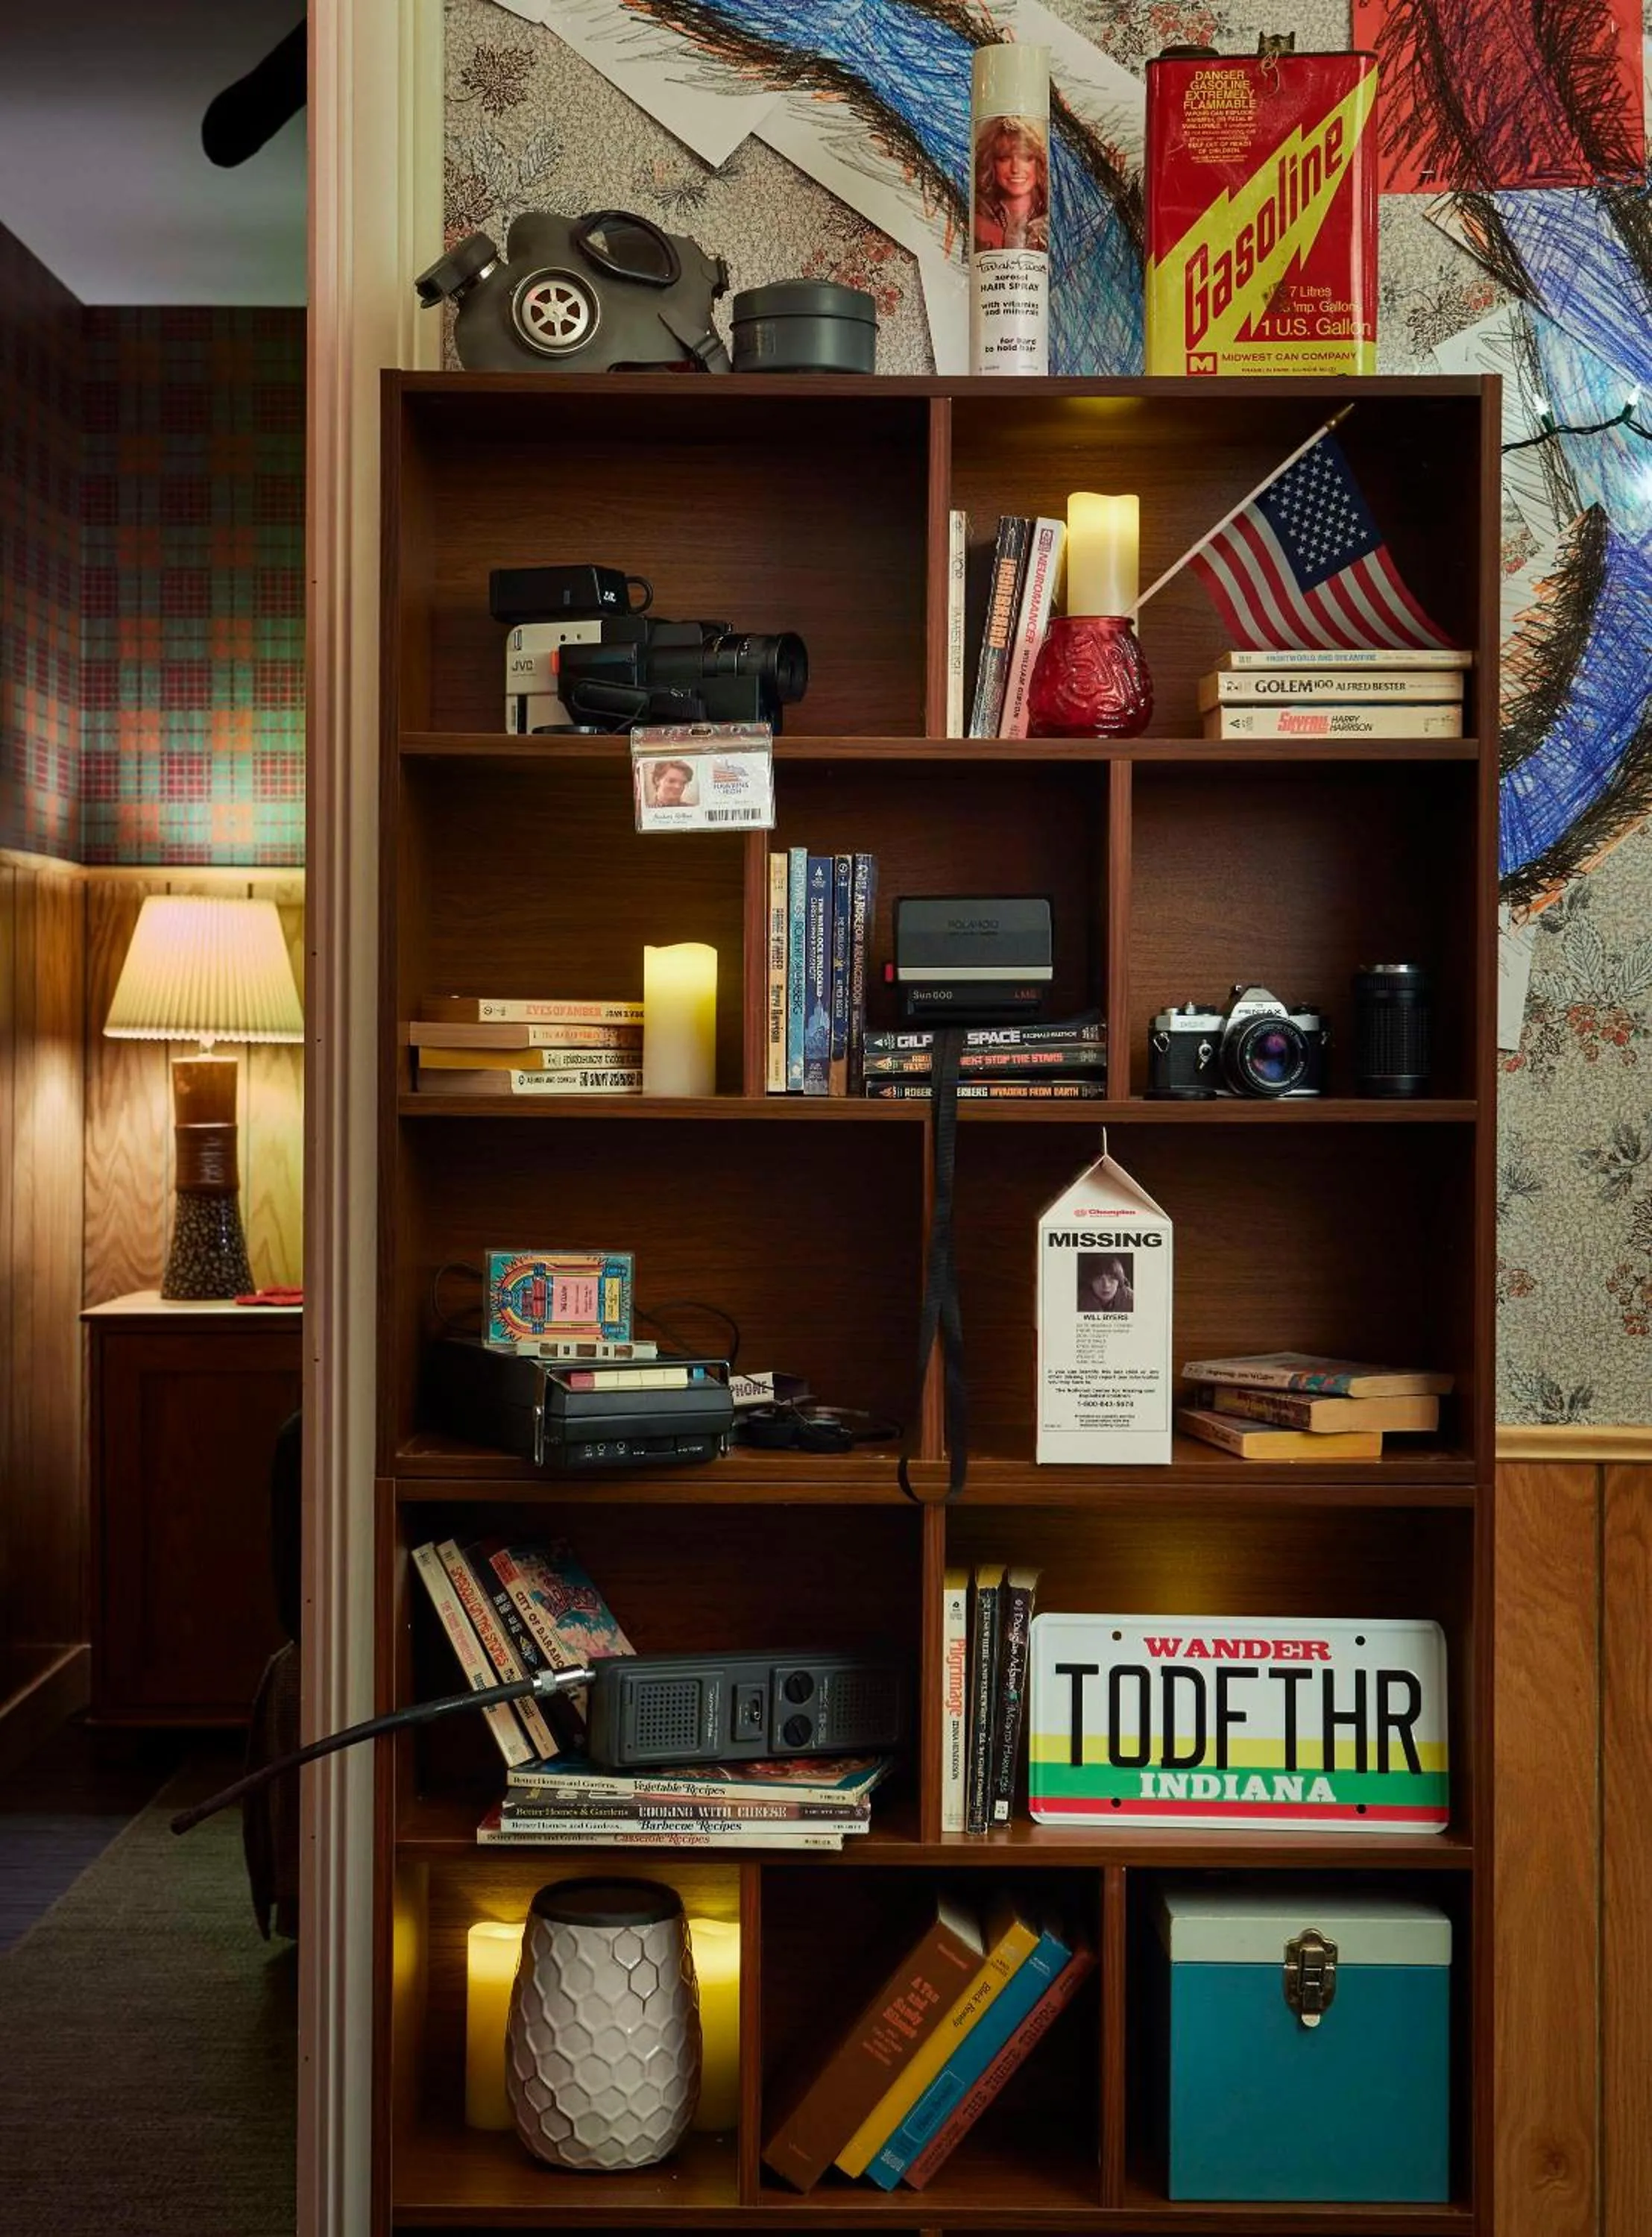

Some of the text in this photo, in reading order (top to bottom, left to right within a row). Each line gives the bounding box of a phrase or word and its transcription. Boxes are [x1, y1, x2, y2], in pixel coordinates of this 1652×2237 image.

[1195, 70, 1244, 81] DANGER
[1190, 80, 1250, 90] GASOLINE
[1185, 89, 1255, 100] EXTREMELY
[1183, 99, 1257, 110] FLAMMABLE
[1185, 116, 1344, 351] Gasoline
[980, 283, 1039, 292] HAIR SPRAY
[1299, 286, 1331, 298] Litres
[981, 301, 1000, 309] with
[1262, 318, 1371, 336] 1 U.S. Gallon
[1222, 353, 1273, 362] MIDWEST
[1302, 352, 1357, 360] COMPANY
[1026, 553, 1049, 644] NEUROMANCER
[512, 660, 533, 671] JVC
[1012, 649, 1032, 719] WILLIAM GIBSON
[1335, 682, 1371, 690] ALFRED
[1372, 682, 1406, 690] BESTER
[1331, 715, 1361, 723] HARRY
[1329, 723, 1373, 731] HARRISON
[794, 850, 805, 919] NIGHTWINGS
[855, 901, 865, 925] ROSE
[854, 925, 864, 943] FOR
[792, 921, 804, 1015] ROBERT SILVERBERG
[852, 944, 864, 1005] ARMAGEDDON
[913, 990, 932, 999] Sun
[933, 990, 953, 1000] 600
[897, 1030, 1021, 1048] GILP SPACE
[960, 1052, 1064, 1066] NEXT STOP THE STARS
[904, 1087, 988, 1097] ROBER ERBERG
[990, 1086, 1079, 1097] INVADERS FROM EARTH
[1048, 1233, 1163, 1248] MISSING
[450, 1565, 476, 1605] SHADOW
[516, 1591, 565, 1669] CITY OF BARABO
[1008, 1613, 1024, 1692] Douglas Adams
[1144, 1637, 1332, 1661] WANDER
[947, 1637, 966, 1717] Pilgrimage
[1055, 1664, 1422, 1775] TODFTHR
[951, 1720, 960, 1780] ZENNA HENDERSON
[566, 1779, 581, 1787] and
[634, 1780, 726, 1796] Vegetable Recipes
[1140, 1772, 1337, 1803] INDIANA
[516, 1808, 628, 1817] Better Homes & Gardens
[639, 1807, 787, 1819] COOKING WITH CHEESE
[512, 1822, 537, 1830] Better
[569, 1822, 584, 1830] and
[639, 1819, 743, 1832] Barbecue Recipes
[667, 1833, 710, 1846] Recipes
[971, 1980, 991, 2006] Black
[962, 2091, 988, 2118] THE
[986, 2050, 1021, 2090] THREE
